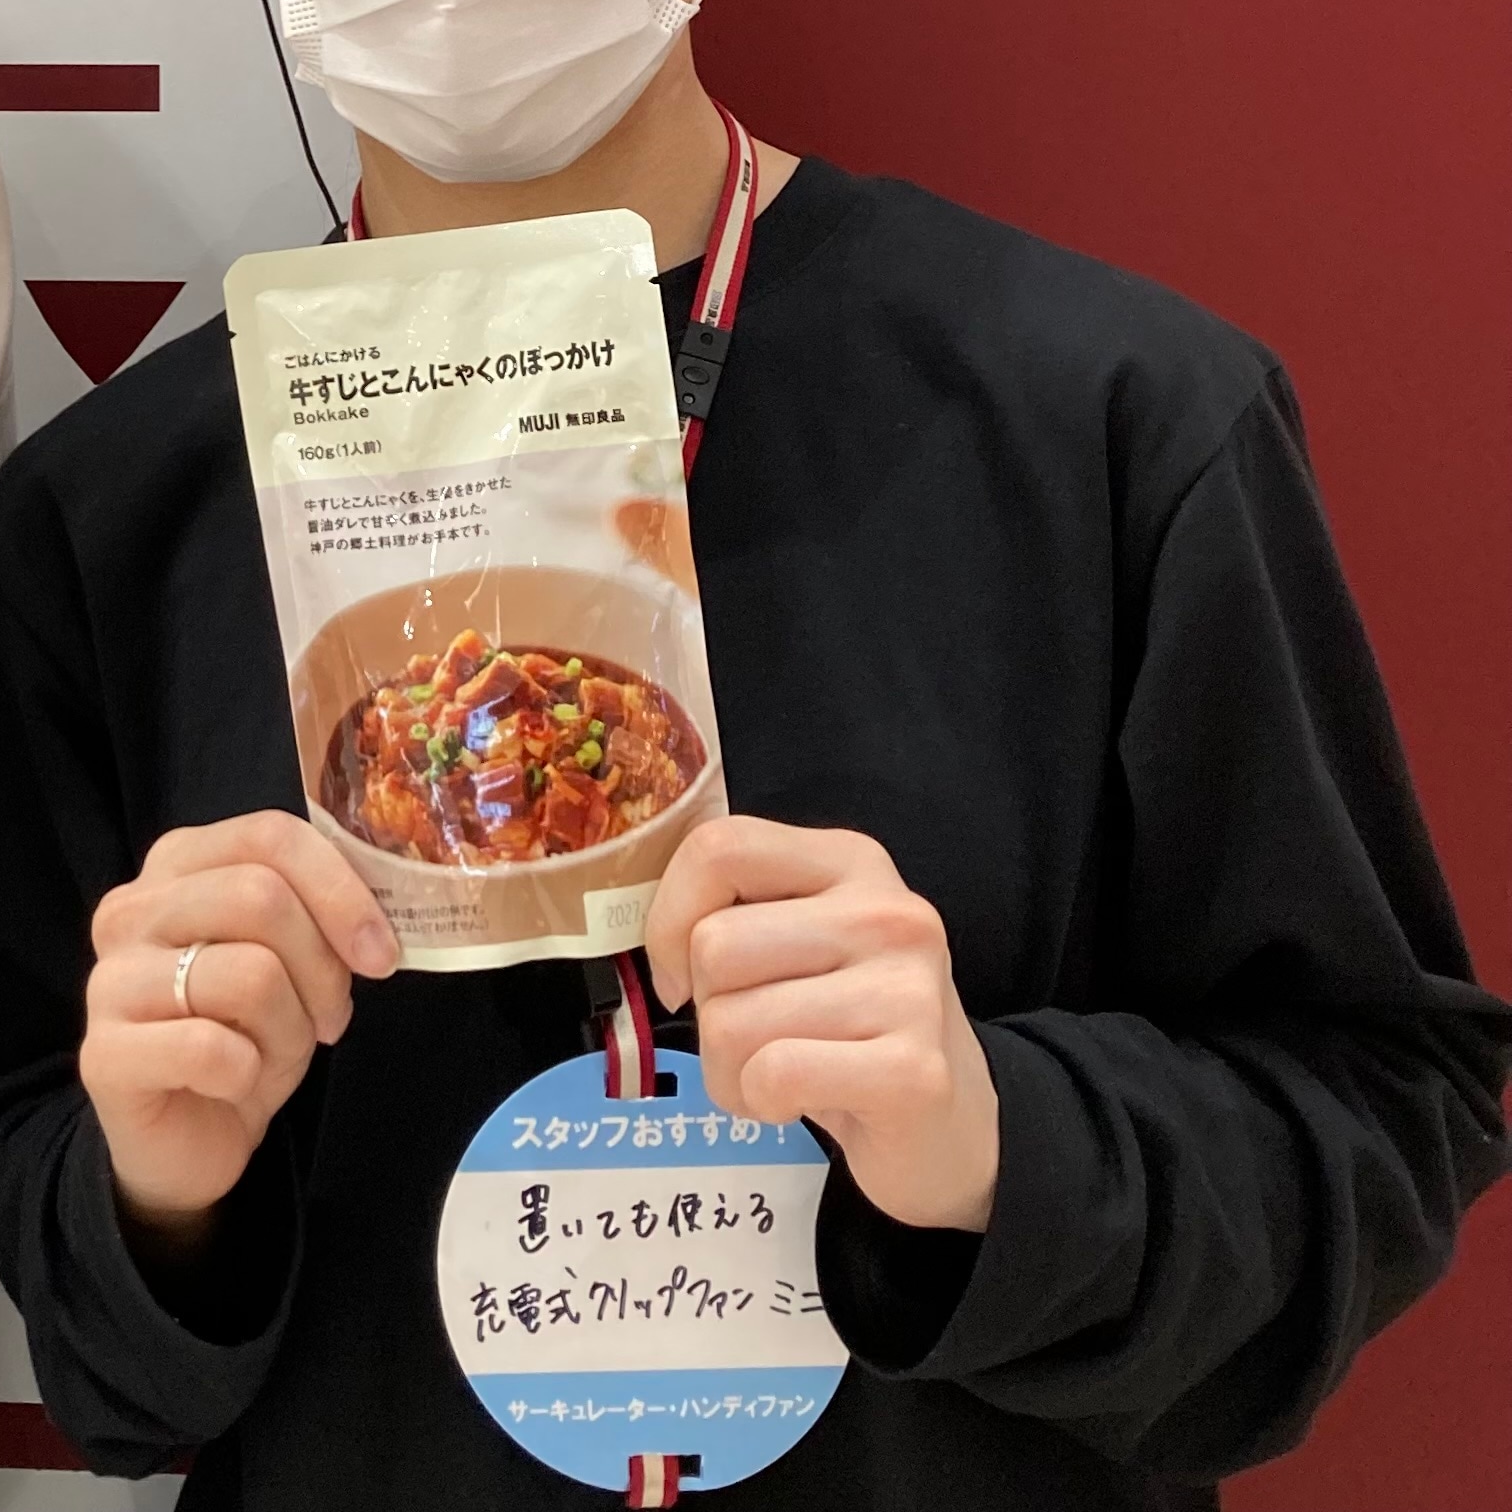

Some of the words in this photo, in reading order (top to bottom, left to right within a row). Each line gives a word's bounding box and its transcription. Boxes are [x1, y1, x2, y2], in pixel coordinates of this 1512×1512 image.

[284, 346, 381, 370] ごはんにかける
[289, 338, 615, 406] 牛すじとこんにゃくのぼっかけ
[293, 406, 370, 425] Bokkake
[519, 413, 560, 434] MUJI
[566, 408, 626, 428] 無印良品
[518, 1183, 775, 1255] 置いても使える
[508, 1396, 816, 1423] サーキュレーター・ハンディファン
